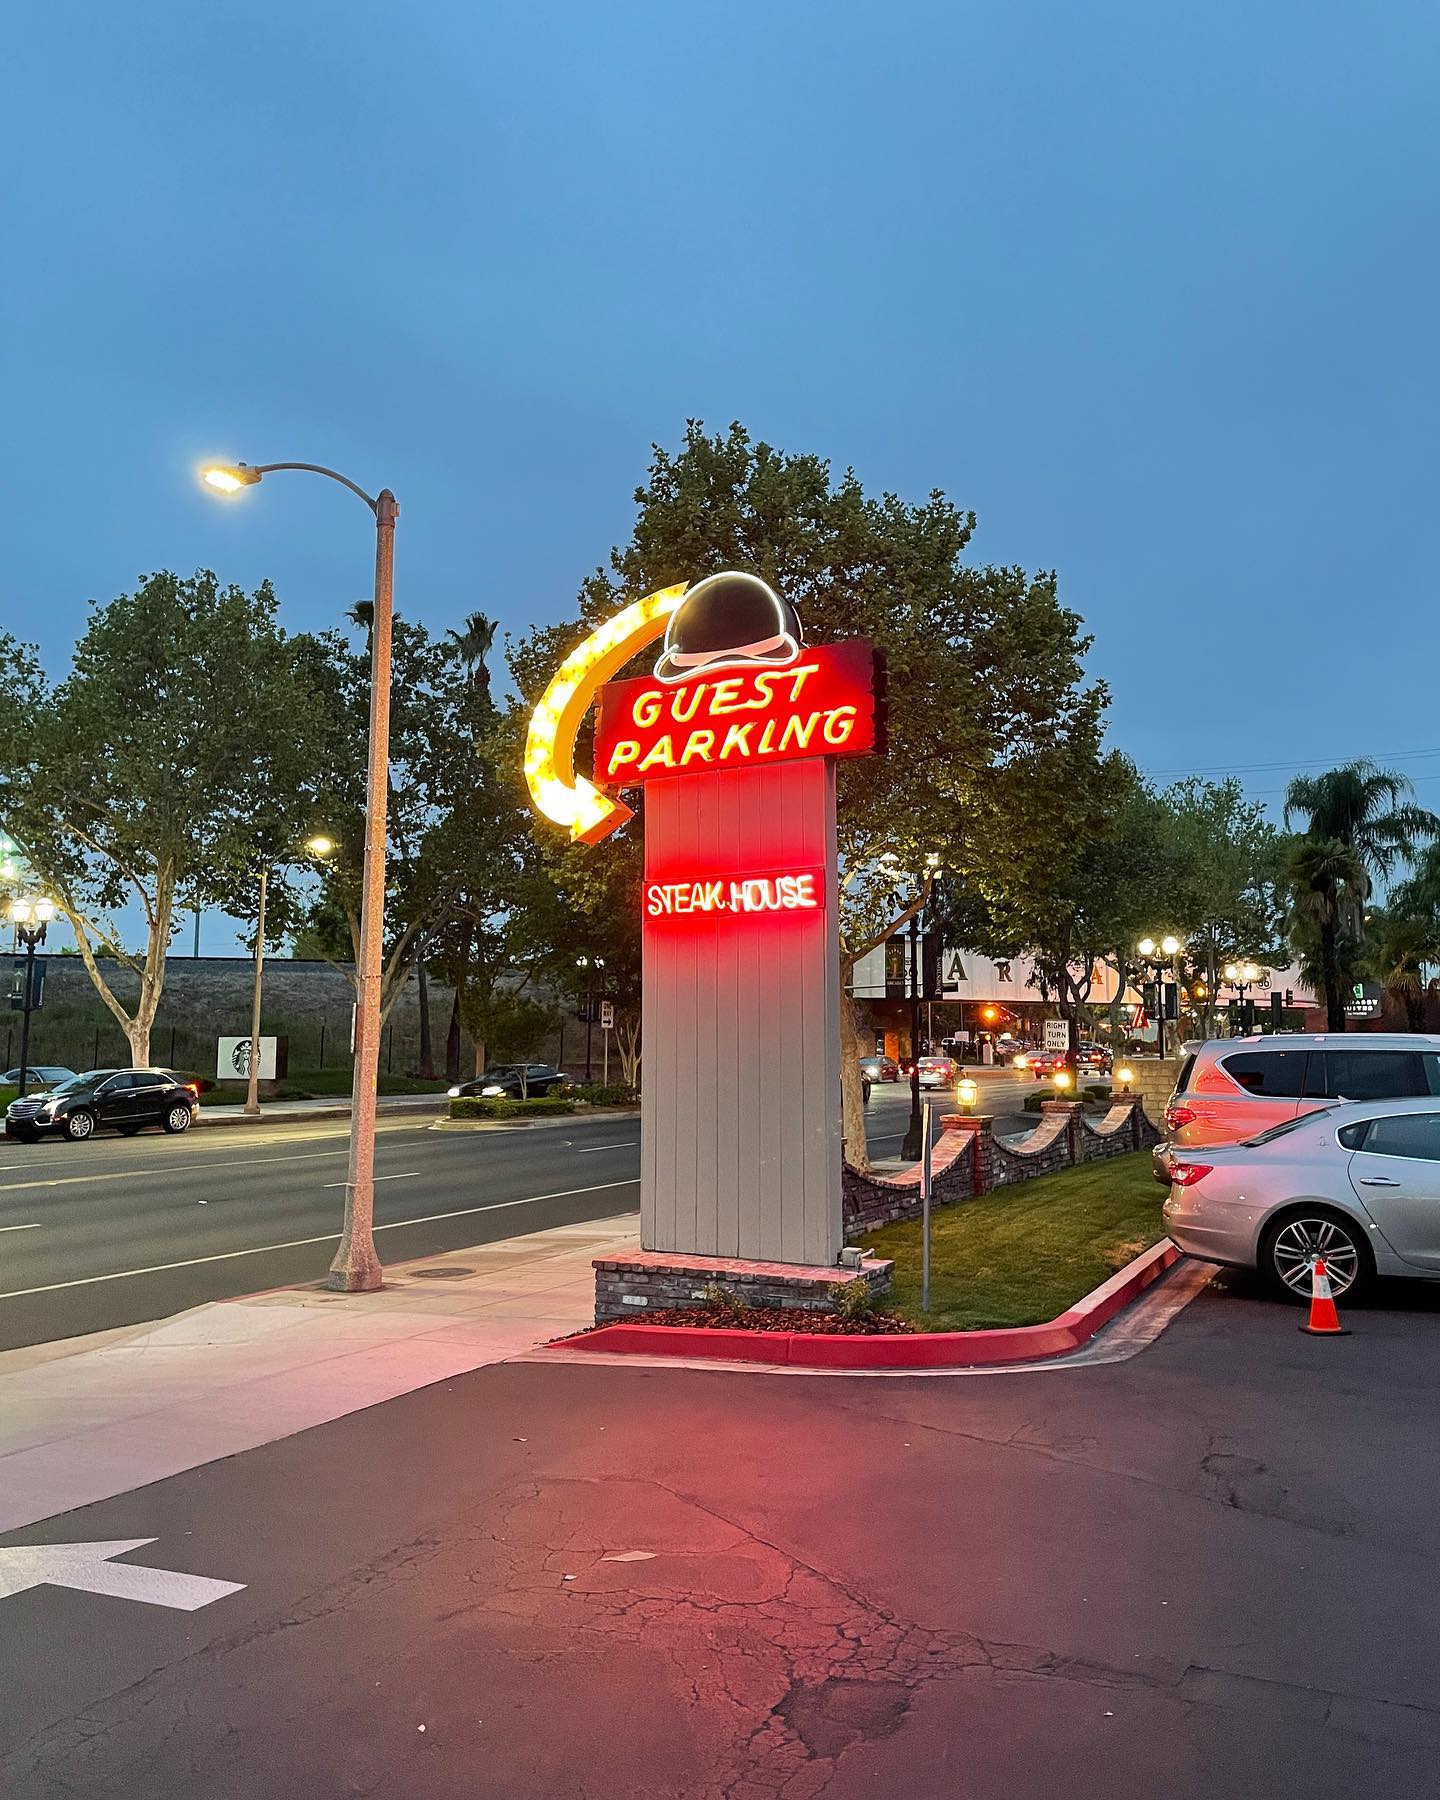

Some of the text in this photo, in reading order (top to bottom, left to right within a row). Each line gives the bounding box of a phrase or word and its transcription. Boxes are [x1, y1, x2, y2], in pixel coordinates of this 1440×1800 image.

[632, 664, 820, 728] GUEST
[607, 706, 858, 776] PARKING
[647, 874, 818, 916] STEAK HOUSE
[1048, 1031, 1066, 1039] TURN
